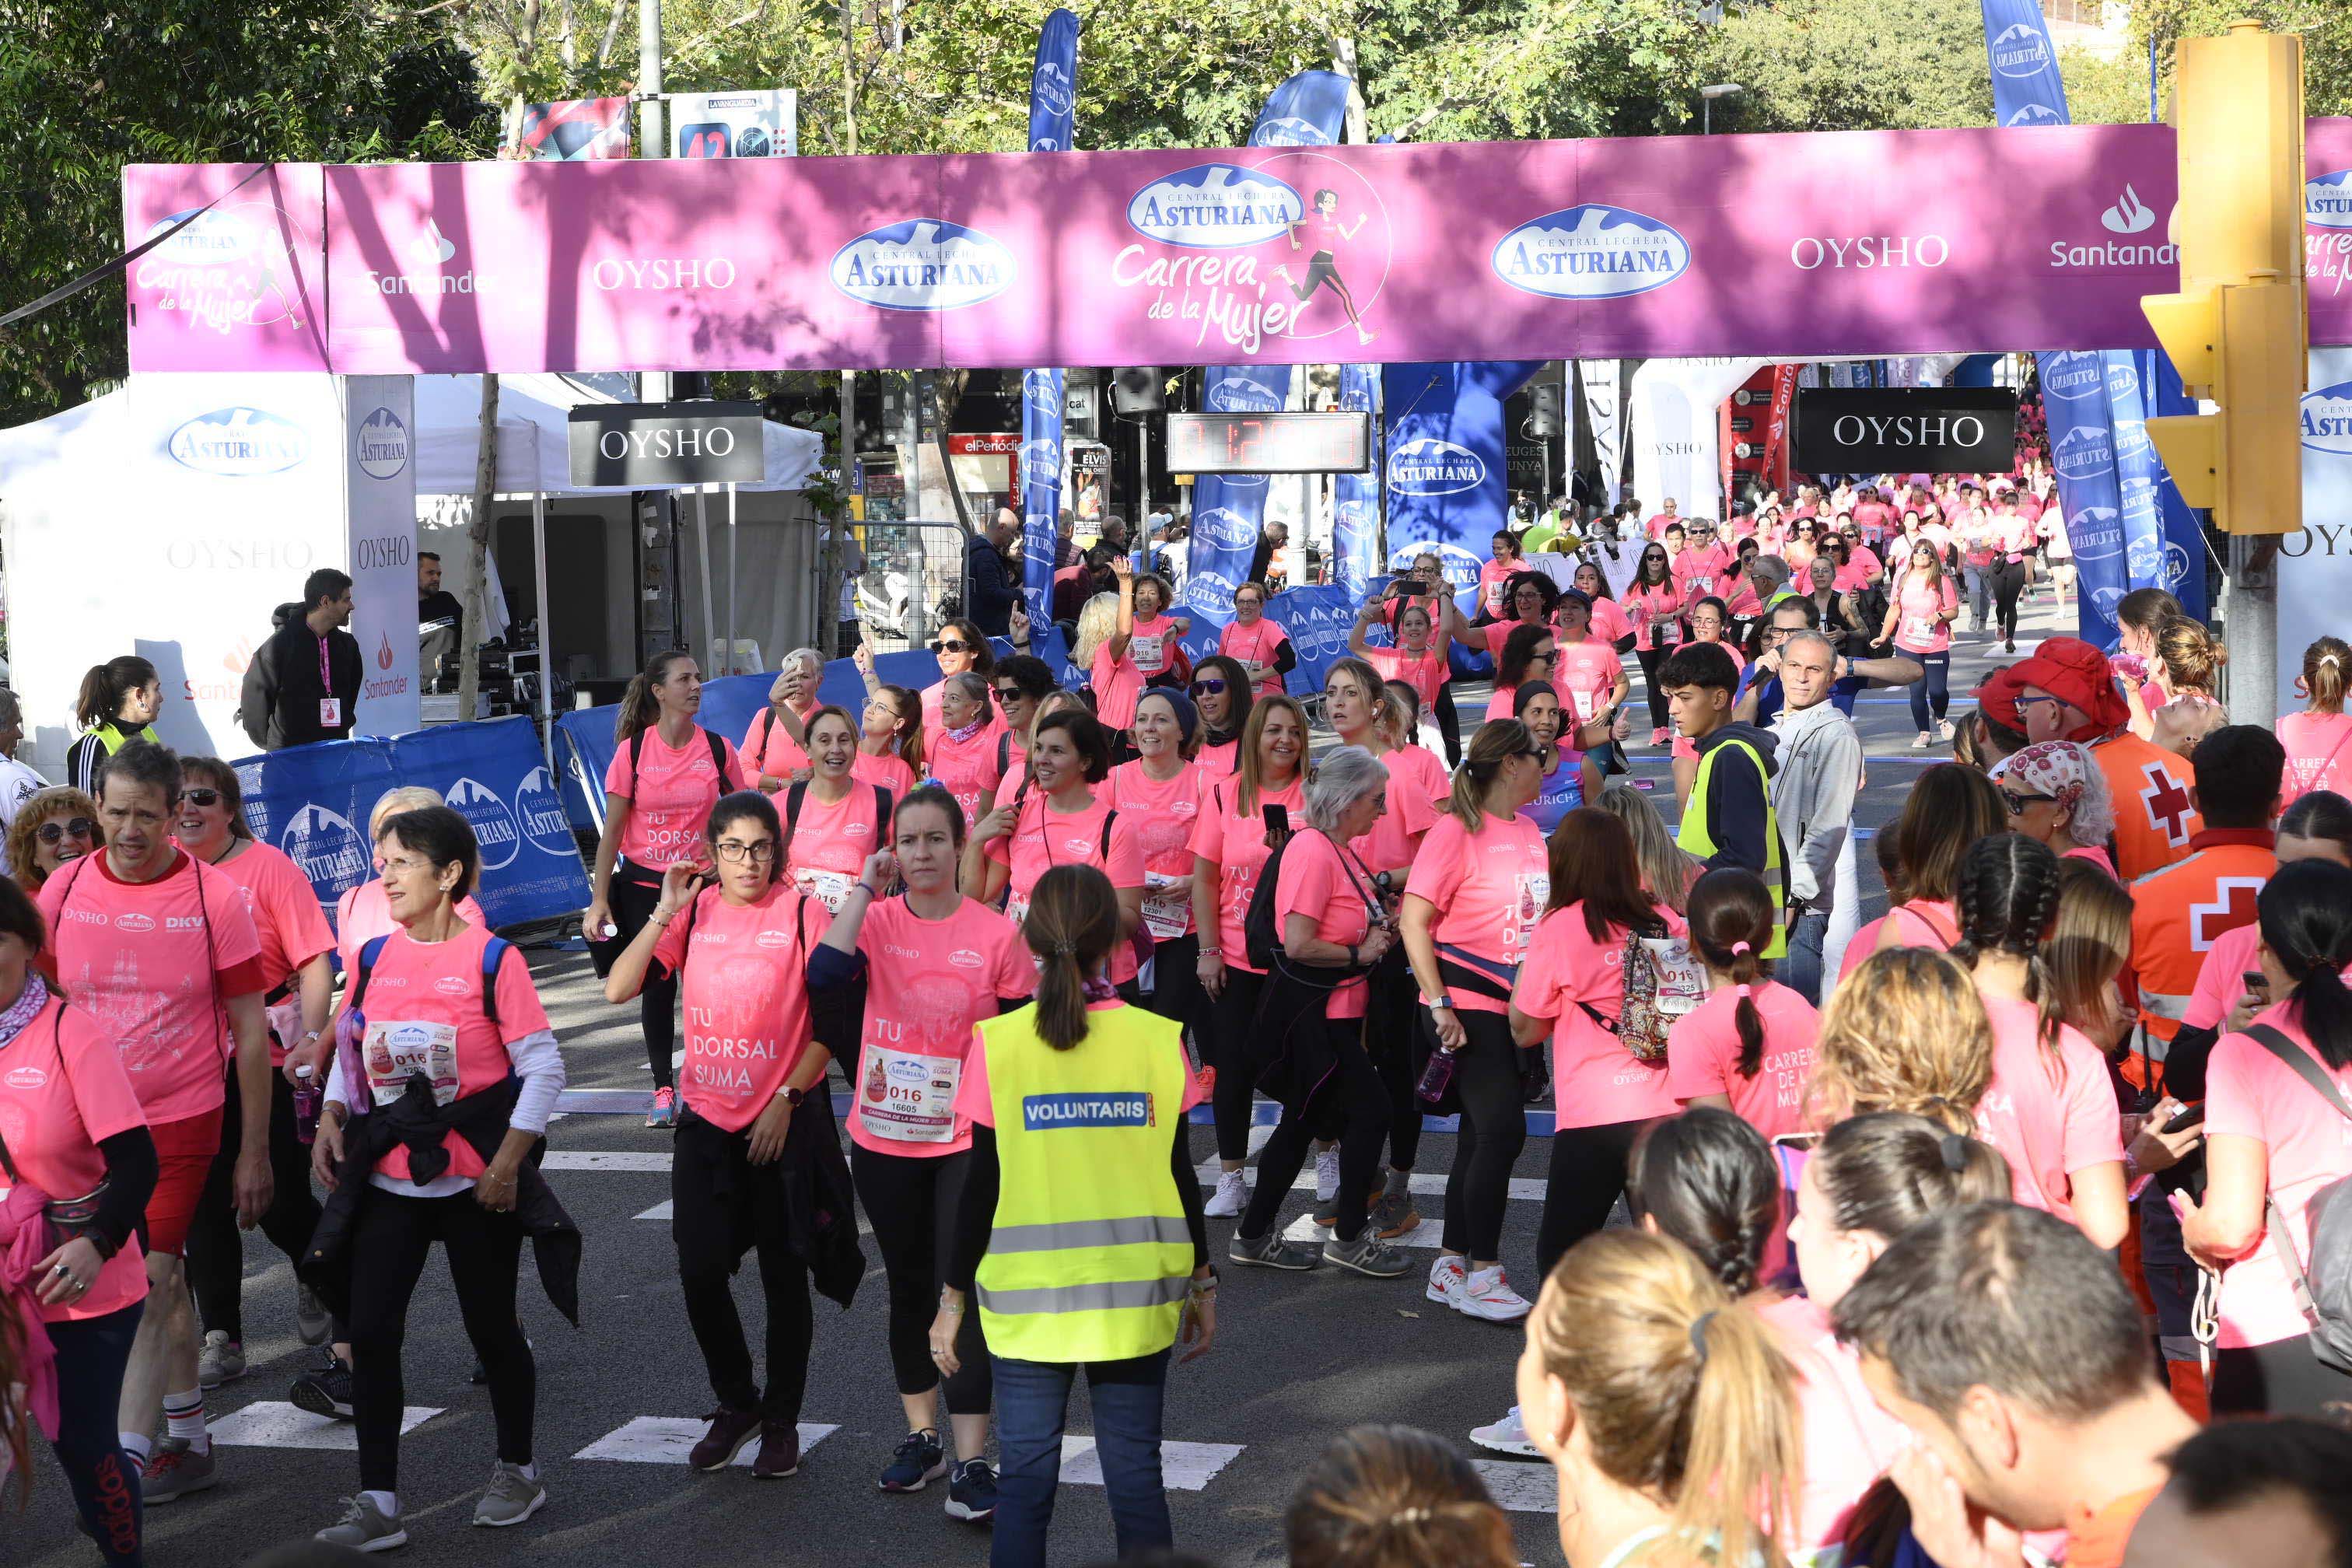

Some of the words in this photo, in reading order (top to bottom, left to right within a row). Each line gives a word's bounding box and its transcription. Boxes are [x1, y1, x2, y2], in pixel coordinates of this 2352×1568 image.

[1140, 195, 1293, 227] ASTURIANA
[1538, 237, 1599, 247] CENTRAL
[1605, 236, 1668, 246] LECHERA
[1790, 235, 1949, 269] OYSHO
[2050, 240, 2181, 267] Santand
[845, 254, 1000, 286] ASTURIANA
[1111, 243, 1258, 287] Carrera
[1509, 241, 1675, 275] ASTURIANA
[136, 258, 229, 289] Carrera
[593, 258, 736, 290] OYSHO
[159, 292, 176, 310] de
[190, 285, 262, 335] Mujer
[1148, 289, 1174, 320] de
[1181, 289, 1200, 319] la
[1195, 283, 1313, 355] Mujer
[1776, 364, 1795, 416] Santa
[600, 427, 735, 460] OYSHO
[1833, 415, 1984, 447] OYSHO
[180, 432, 301, 460] ASTURIANA
[361, 434, 405, 462] ASTURIANA
[1391, 462, 1479, 484] ASTURIANA
[166, 538, 314, 570] OYSHO
[358, 534, 410, 571] OYSHO
[365, 674, 408, 700] Santander
[523, 803, 569, 837] ASTUR
[647, 812, 666, 825] TU
[472, 818, 516, 847] URIANA
[647, 830, 701, 845] DORSA
[1230, 866, 1249, 880] TU
[165, 916, 205, 928] DKV
[1668, 968, 1693, 982] 016
[691, 1006, 712, 1028] TU
[875, 1017, 902, 1043] TU
[395, 1053, 427, 1066] 016
[694, 1035, 778, 1059] DORSAL
[1764, 1048, 1815, 1073] CARRER
[695, 1063, 753, 1088] SUMA
[1778, 1069, 1795, 1089] DE
[890, 1086, 922, 1102] 016
[891, 1103, 917, 1114] 16605
[1027, 1101, 1145, 1122] VOLUNTARIS
[865, 1120, 891, 1132] OYSHO
[93, 1453, 138, 1554] adidas
